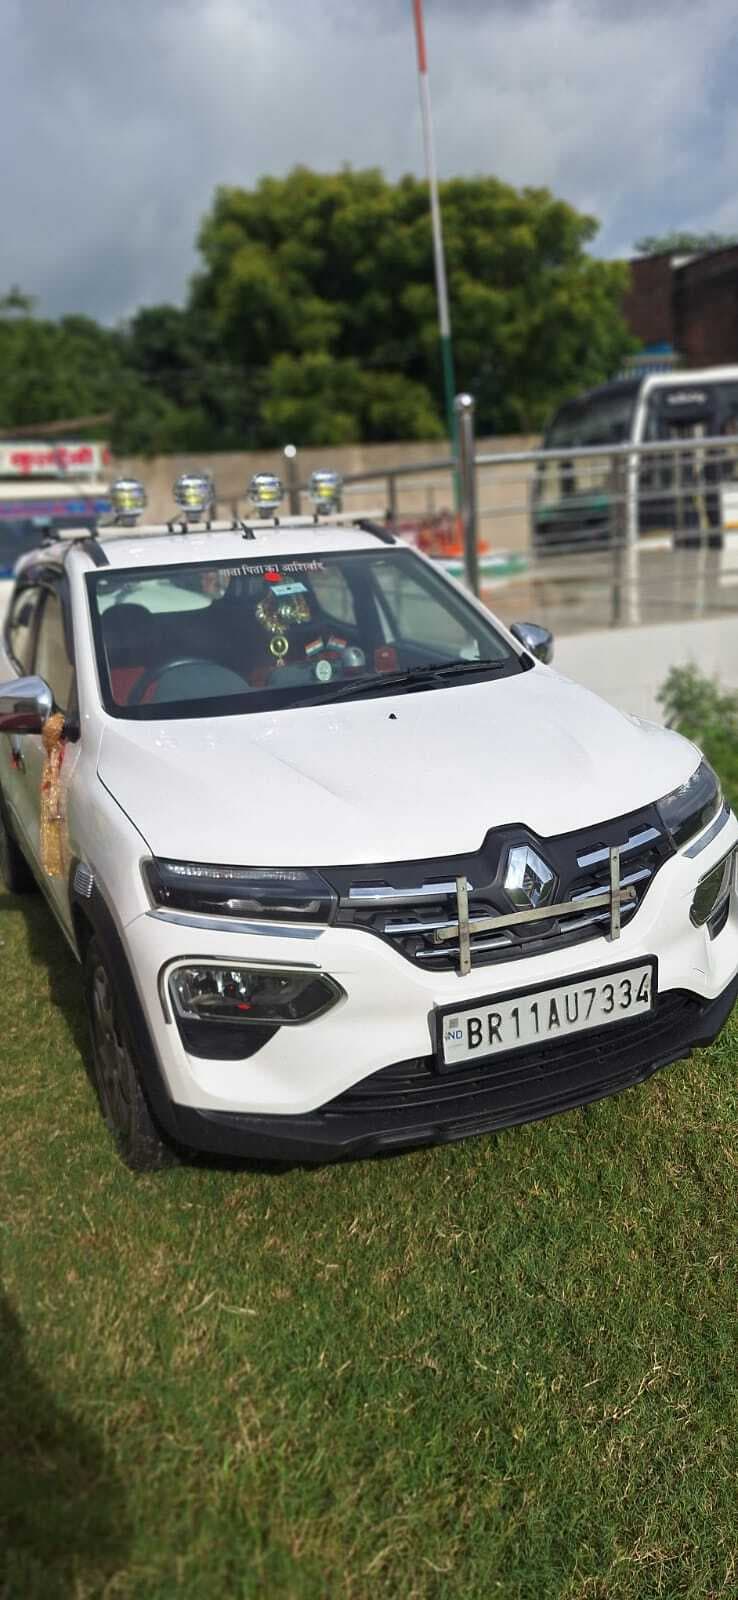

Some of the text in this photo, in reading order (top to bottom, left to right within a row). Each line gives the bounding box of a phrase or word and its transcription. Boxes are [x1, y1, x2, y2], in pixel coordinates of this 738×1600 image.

[241, 563, 264, 576] पिता
[264, 562, 279, 573] का
[466, 972, 650, 1050] BR11AU7334
